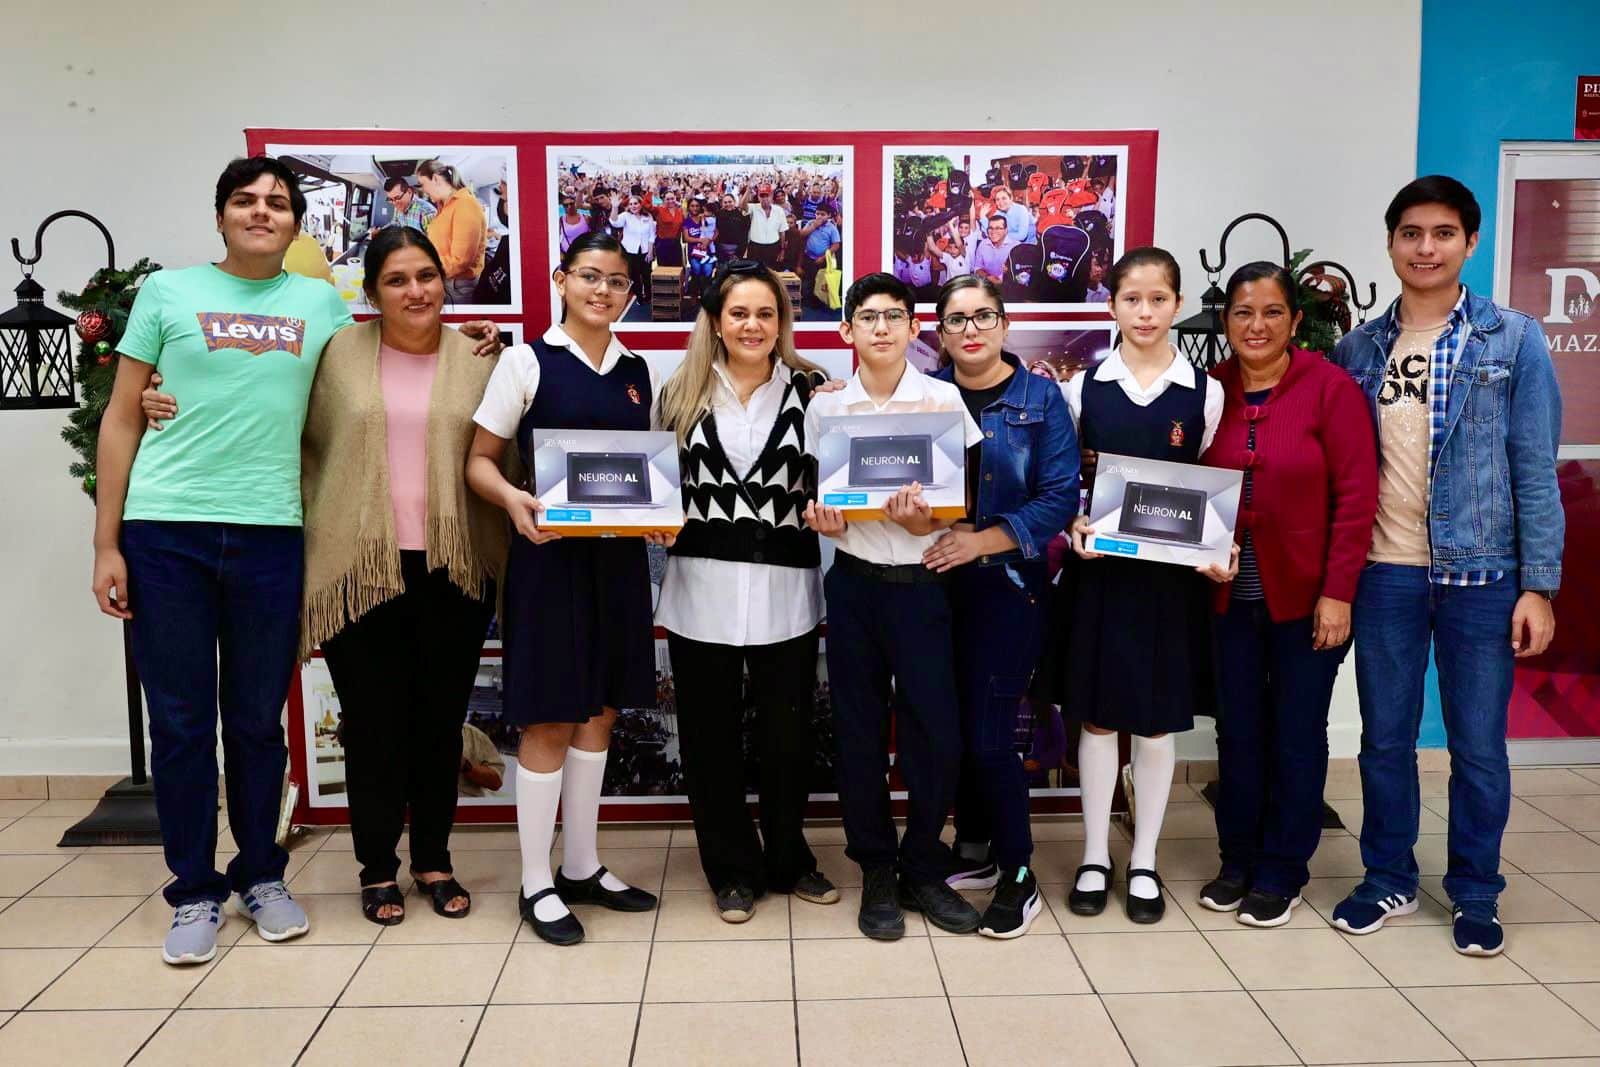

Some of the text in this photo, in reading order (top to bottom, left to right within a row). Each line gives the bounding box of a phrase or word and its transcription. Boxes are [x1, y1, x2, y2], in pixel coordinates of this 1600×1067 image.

[1545, 334, 1600, 352] MAZ
[1387, 354, 1432, 379] AC
[861, 455, 921, 466] NEURON AL
[578, 473, 639, 483] NEURON AL
[1133, 503, 1193, 521] NEURON AL
